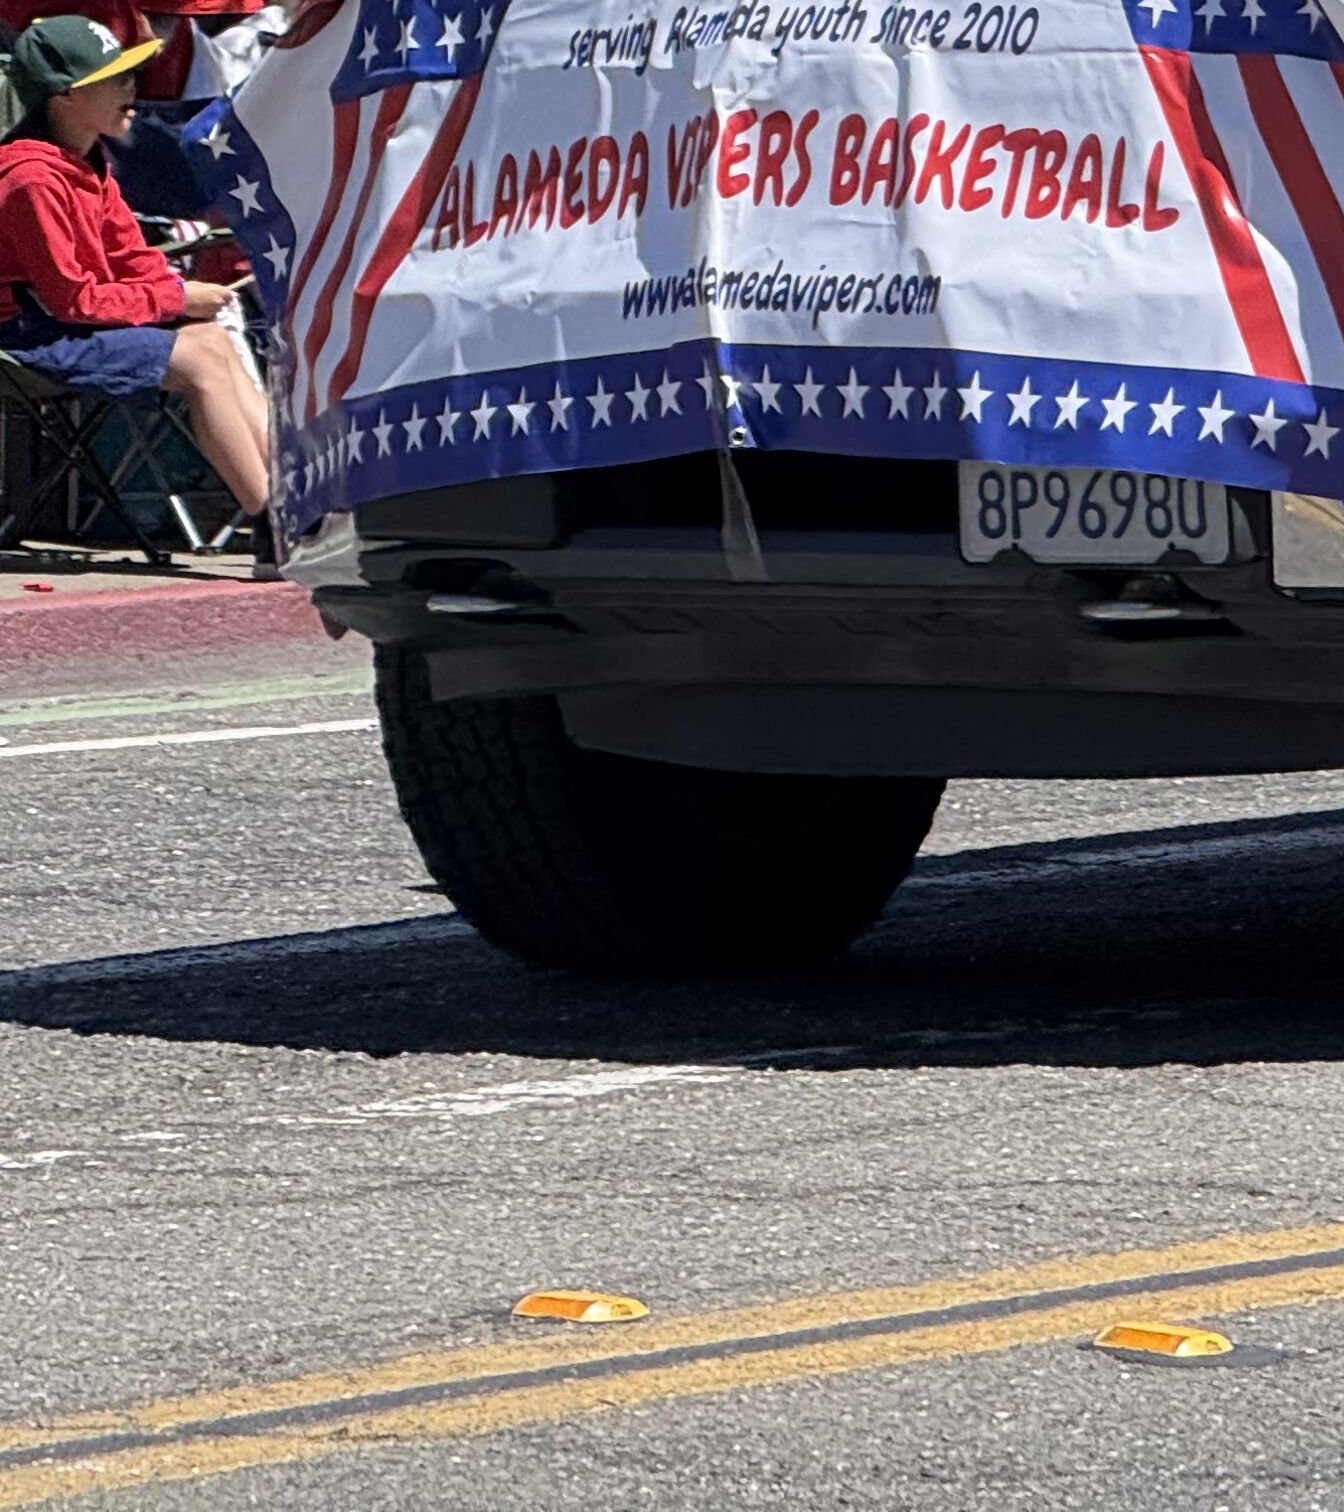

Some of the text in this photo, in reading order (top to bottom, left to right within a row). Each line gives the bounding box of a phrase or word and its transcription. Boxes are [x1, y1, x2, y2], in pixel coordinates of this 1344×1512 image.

[562, 13, 659, 76] serving
[952, 1, 1041, 55] 2010
[431, 107, 1181, 253] ALAMEDA VIPERS BASKETBALL
